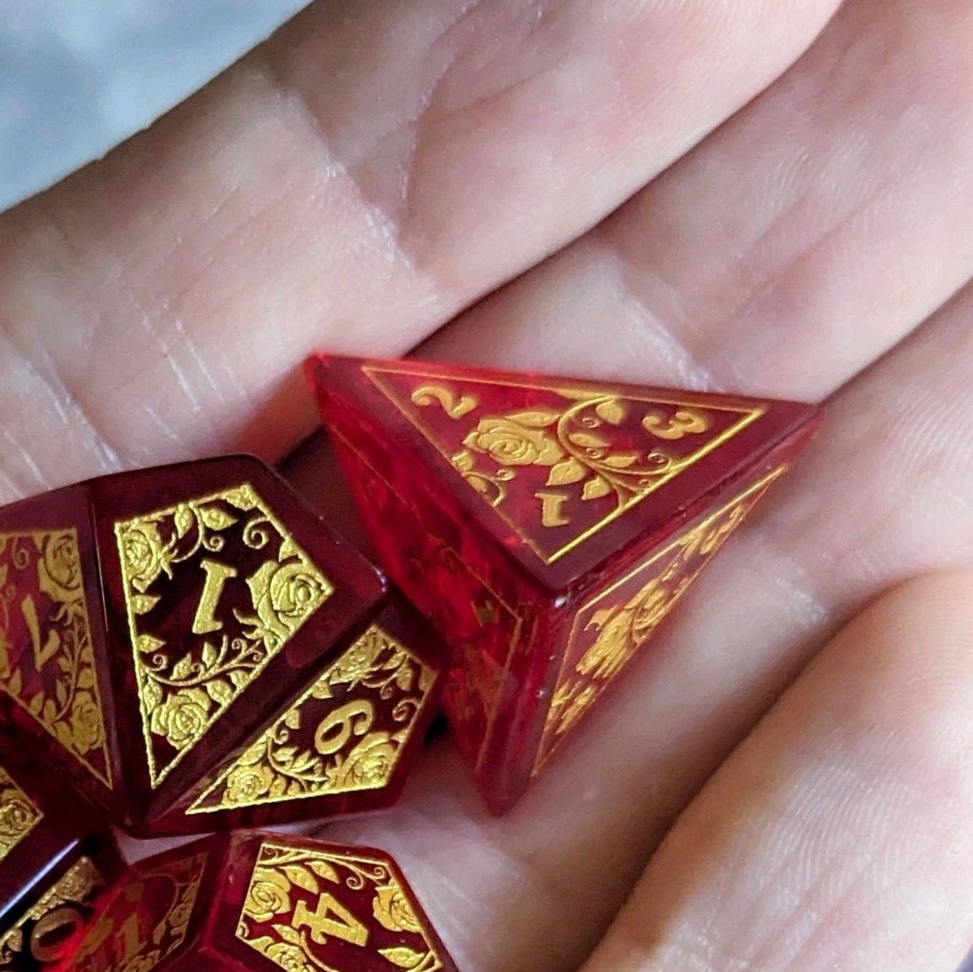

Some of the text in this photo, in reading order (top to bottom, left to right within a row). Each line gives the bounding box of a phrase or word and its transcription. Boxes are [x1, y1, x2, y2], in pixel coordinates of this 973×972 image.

[410, 386, 478, 419] 2
[641, 412, 707, 441] 3
[534, 492, 569, 528] 1
[192, 561, 237, 634] 1
[291, 893, 372, 948] 4
